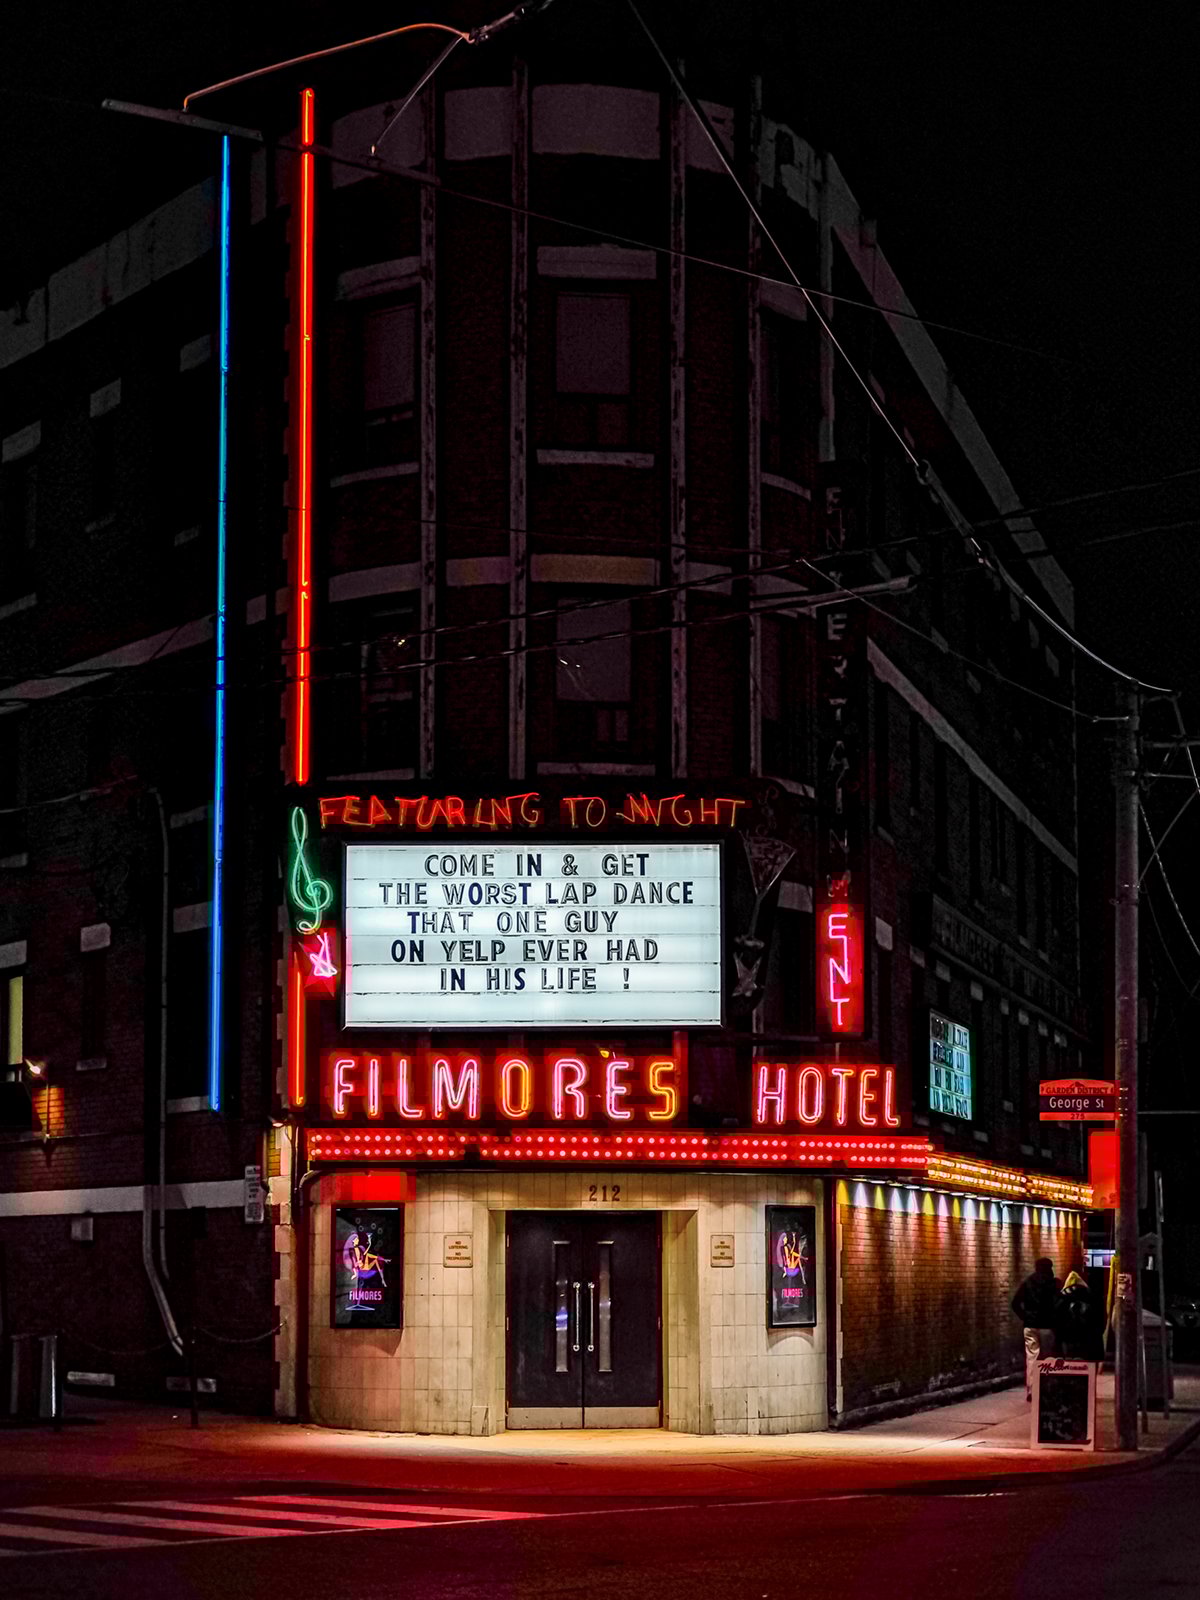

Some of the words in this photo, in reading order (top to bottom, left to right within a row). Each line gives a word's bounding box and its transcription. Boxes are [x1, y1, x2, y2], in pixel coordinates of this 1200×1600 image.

[318, 791, 540, 829] FEATURING
[423, 853, 495, 877] COME
[516, 853, 543, 877] IN
[560, 853, 579, 877] &
[601, 852, 650, 877] GET
[379, 882, 428, 905] THE
[442, 882, 532, 905] WORST
[545, 882, 597, 905] LAP
[613, 881, 695, 904] DANCE
[407, 911, 474, 934] THAT
[496, 911, 548, 934] ONE
[564, 910, 619, 933] GUY
[391, 940, 425, 963] ON
[442, 939, 506, 962] YELP
[523, 939, 588, 962] EVER
[606, 939, 659, 962] HAD
[440, 968, 466, 991] IN
[486, 968, 526, 991] HIS
[541, 967, 597, 990] LIFE
[622, 967, 630, 990] !
[332, 1057, 678, 1121] FILMORES
[756, 1064, 900, 1126] HOTEL
[1046, 1086, 1075, 1094] GARDEN
[1077, 1086, 1109, 1094] DISTRICT
[1049, 1096, 1090, 1111] George
[1095, 1098, 1105, 1108] St
[588, 1184, 621, 1202] 212
[349, 1290, 382, 1300] FILMORES
